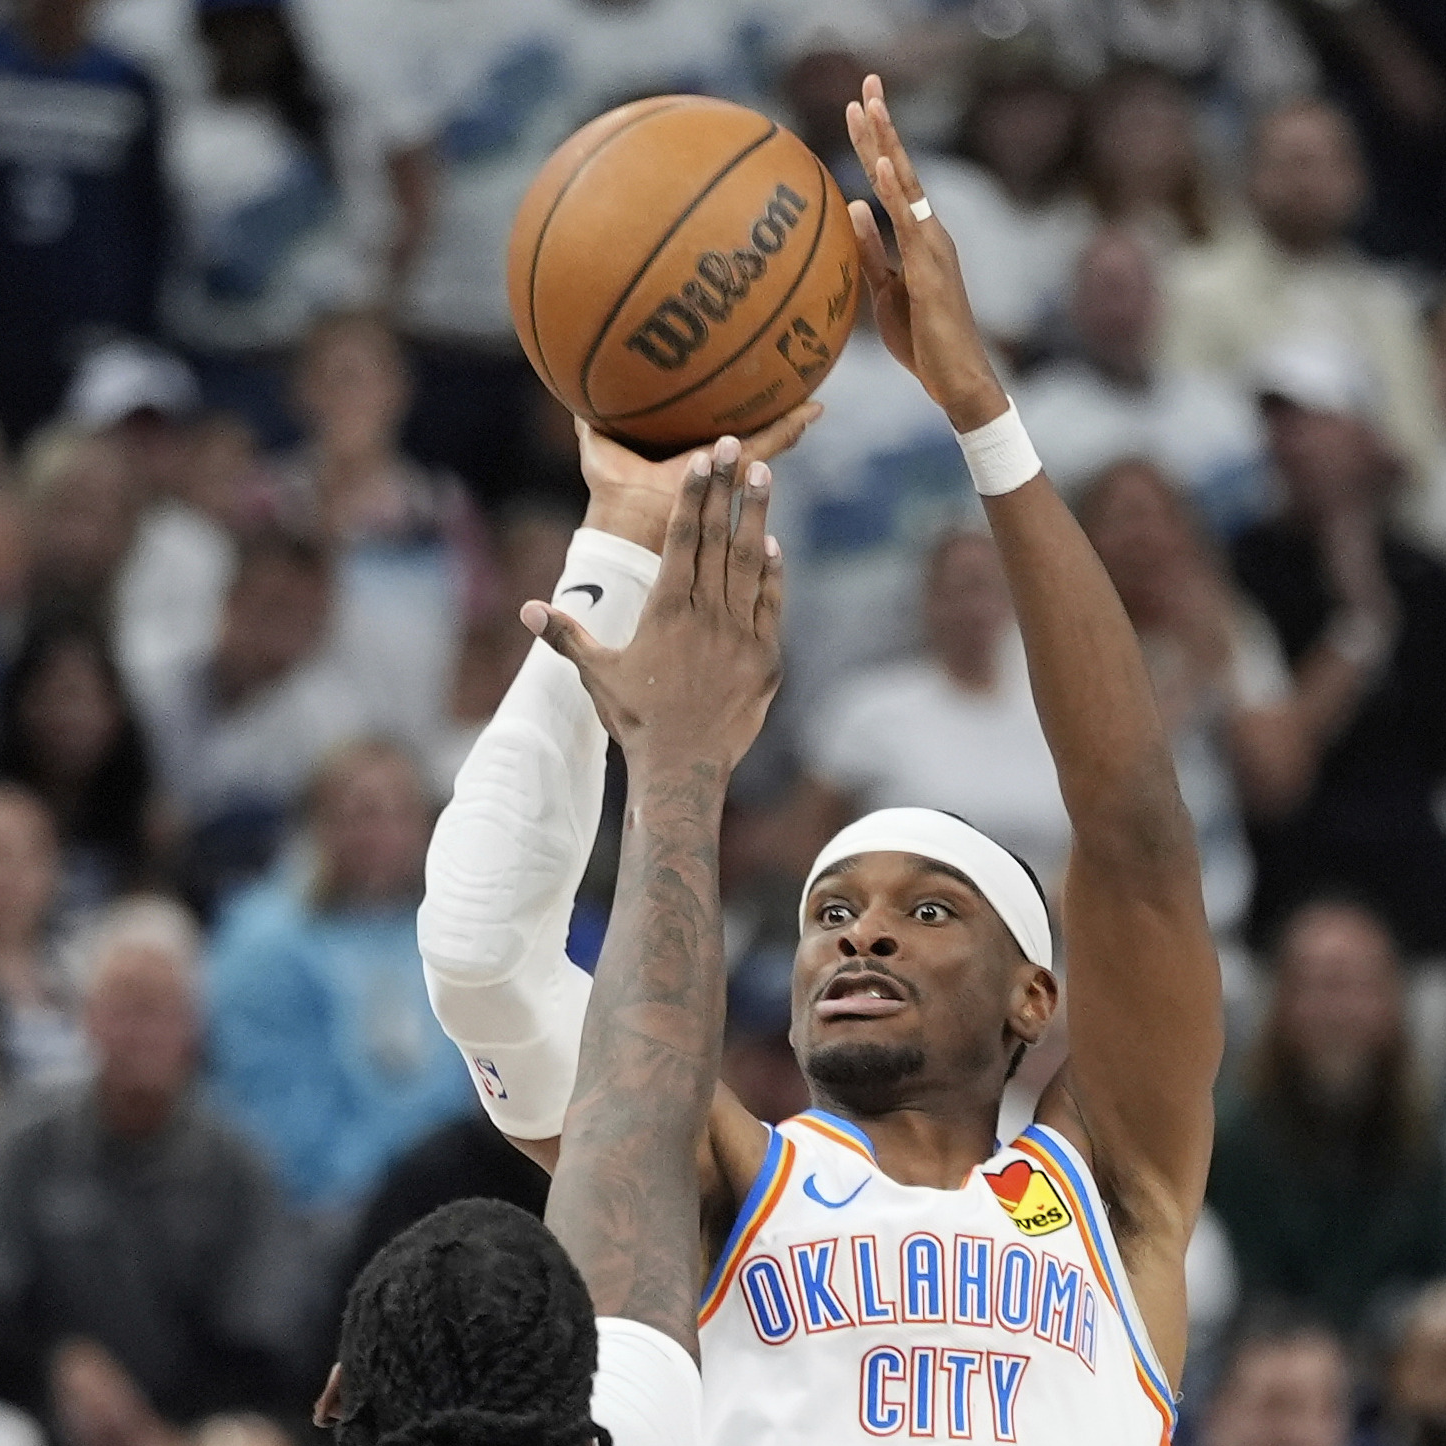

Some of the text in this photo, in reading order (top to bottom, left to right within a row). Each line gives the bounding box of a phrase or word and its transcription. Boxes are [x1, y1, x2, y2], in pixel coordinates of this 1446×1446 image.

[624, 182, 808, 371] Wilson
[739, 1231, 1096, 1376] OKLAHOMA
[859, 1345, 1031, 1443] CITY
